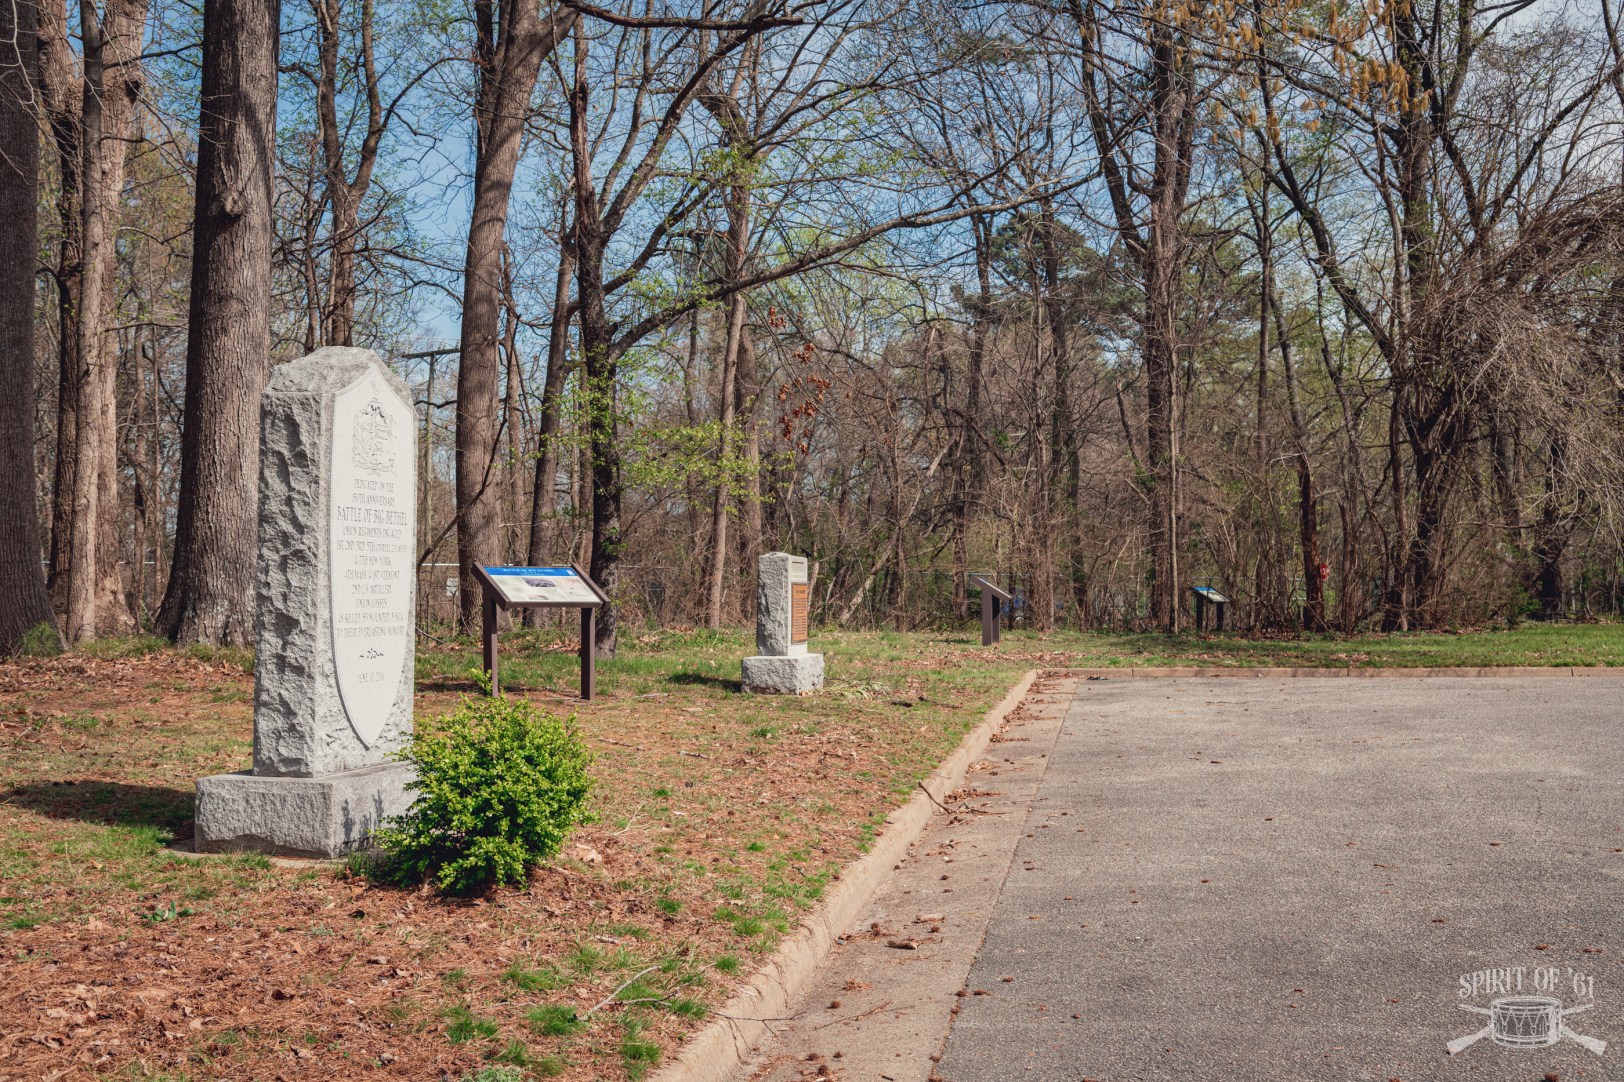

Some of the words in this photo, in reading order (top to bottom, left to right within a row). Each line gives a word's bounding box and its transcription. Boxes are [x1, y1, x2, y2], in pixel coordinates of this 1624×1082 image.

[337, 505, 361, 522] BATTLE
[364, 508, 372, 523] OF
[374, 509, 384, 524] BIG
[386, 510, 408, 526] BETHEL
